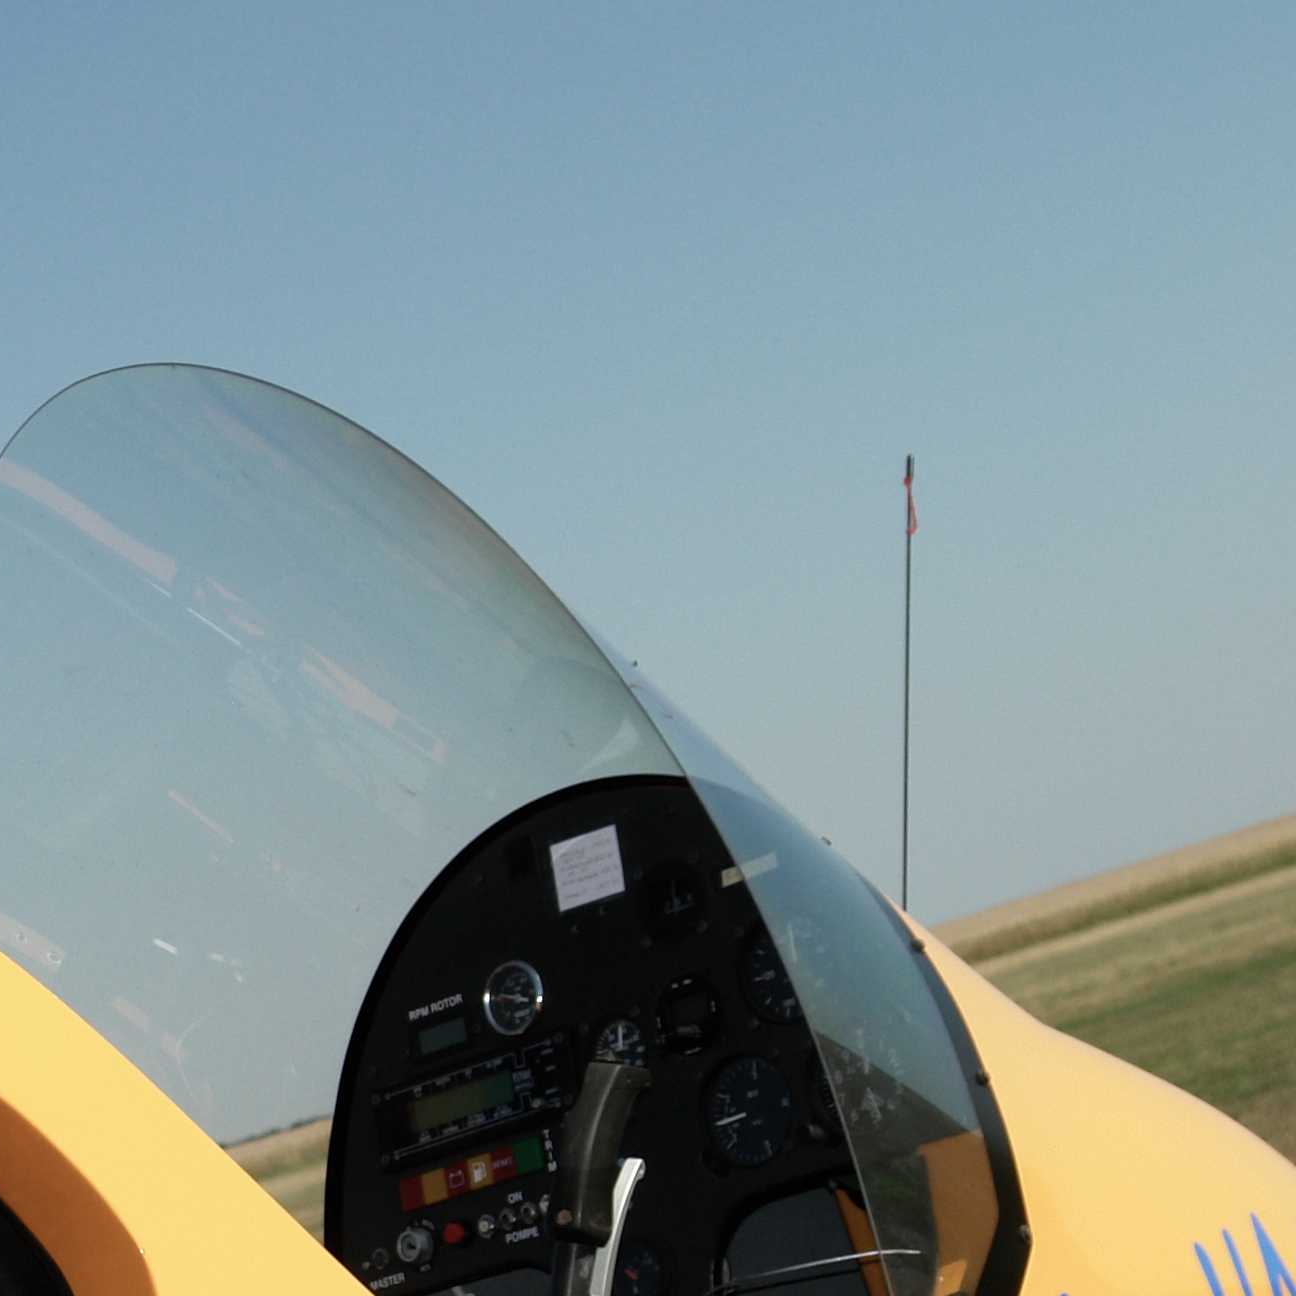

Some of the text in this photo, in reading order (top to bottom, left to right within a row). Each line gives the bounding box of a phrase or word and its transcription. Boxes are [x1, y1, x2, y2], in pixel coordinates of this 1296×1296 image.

[408, 993, 463, 1021] RPM ROTOR
[508, 1191, 523, 1204] ON
[505, 1226, 540, 1244] POMPE
[370, 1272, 406, 1291] MASTER
